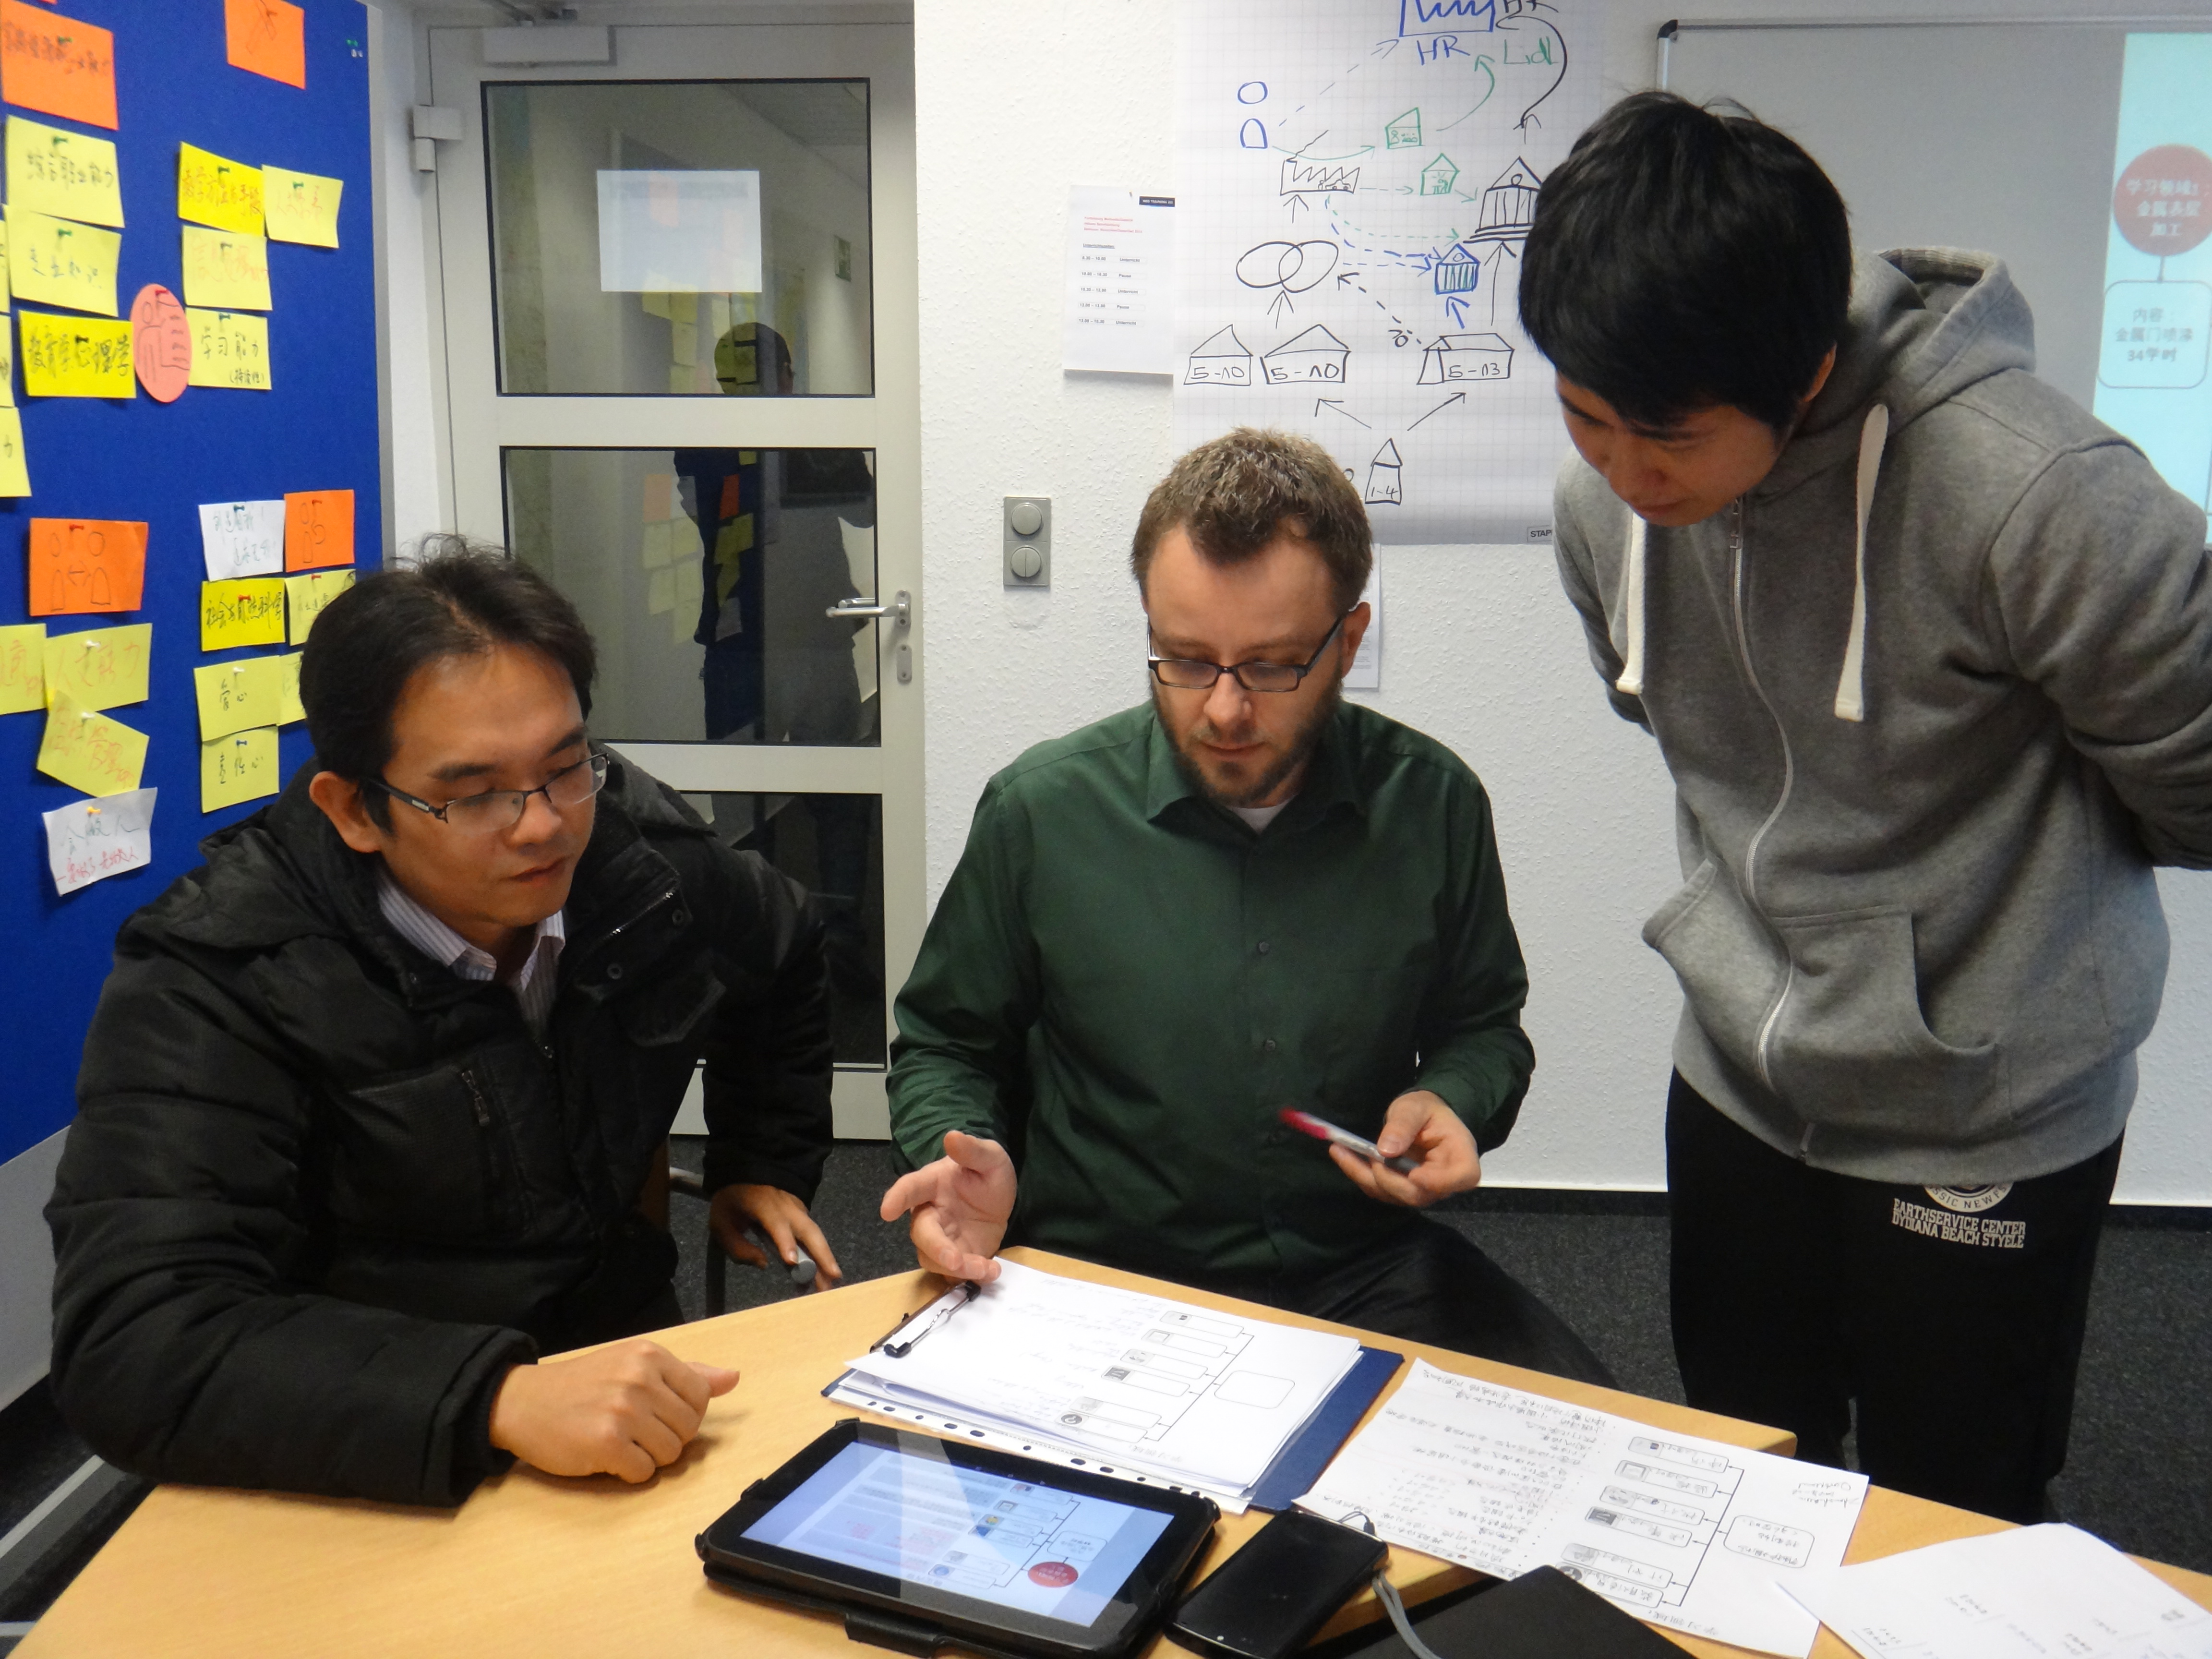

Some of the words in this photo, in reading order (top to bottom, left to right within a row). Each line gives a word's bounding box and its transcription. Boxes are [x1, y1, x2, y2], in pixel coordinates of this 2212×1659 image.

[1417, 35, 1470, 66] HR
[2127, 347, 2177, 362] 34学时
[1530, 529, 1552, 538] STAP
[1964, 1195, 1993, 1209] NEW
[1893, 1198, 1979, 1231] EARTHSERVICE
[1981, 1219, 2026, 1235] CENTER
[1940, 1226, 1981, 1246] BEACH
